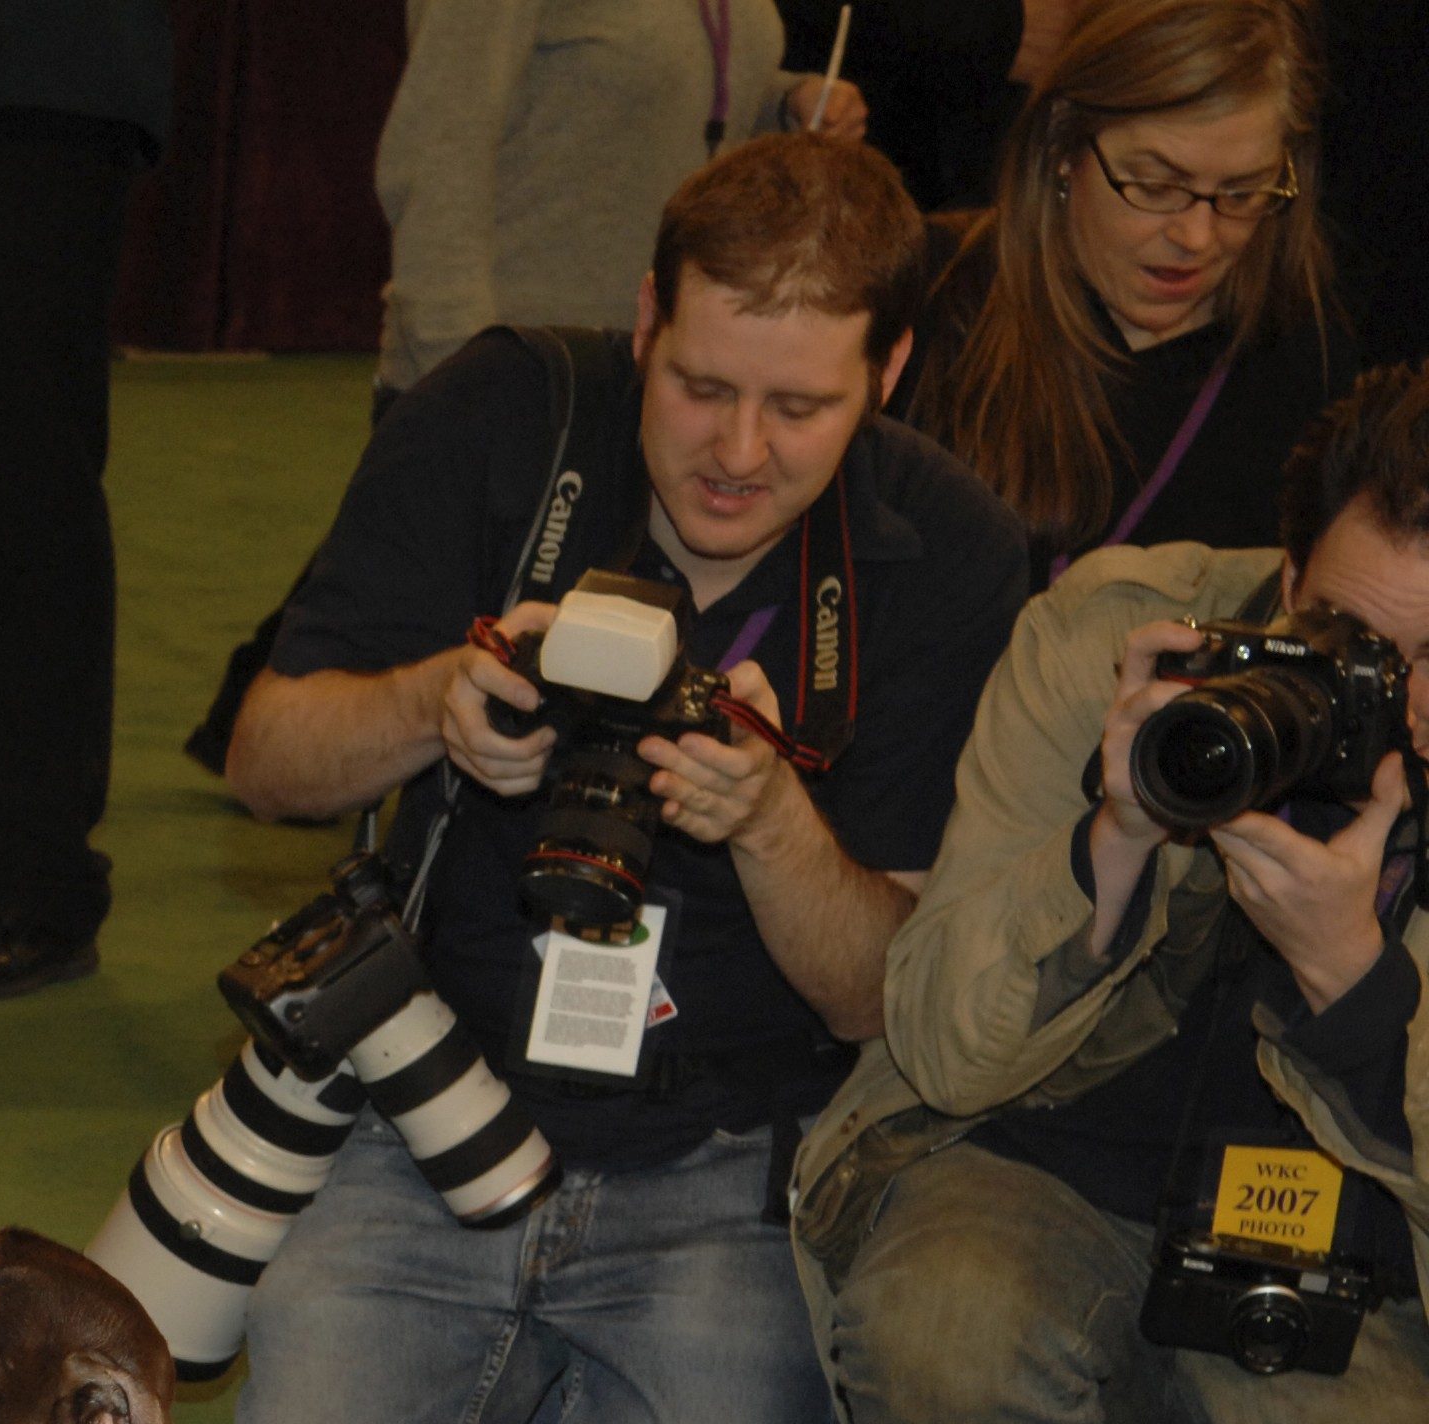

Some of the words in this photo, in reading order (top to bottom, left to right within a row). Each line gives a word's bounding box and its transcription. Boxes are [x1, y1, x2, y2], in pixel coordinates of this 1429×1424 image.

[531, 470, 583, 583] Canon
[814, 575, 841, 691] Canon
[1256, 1162, 1308, 1181] WKC
[1234, 1183, 1321, 1217] 2007
[1239, 1218, 1306, 1238] PHOTO
